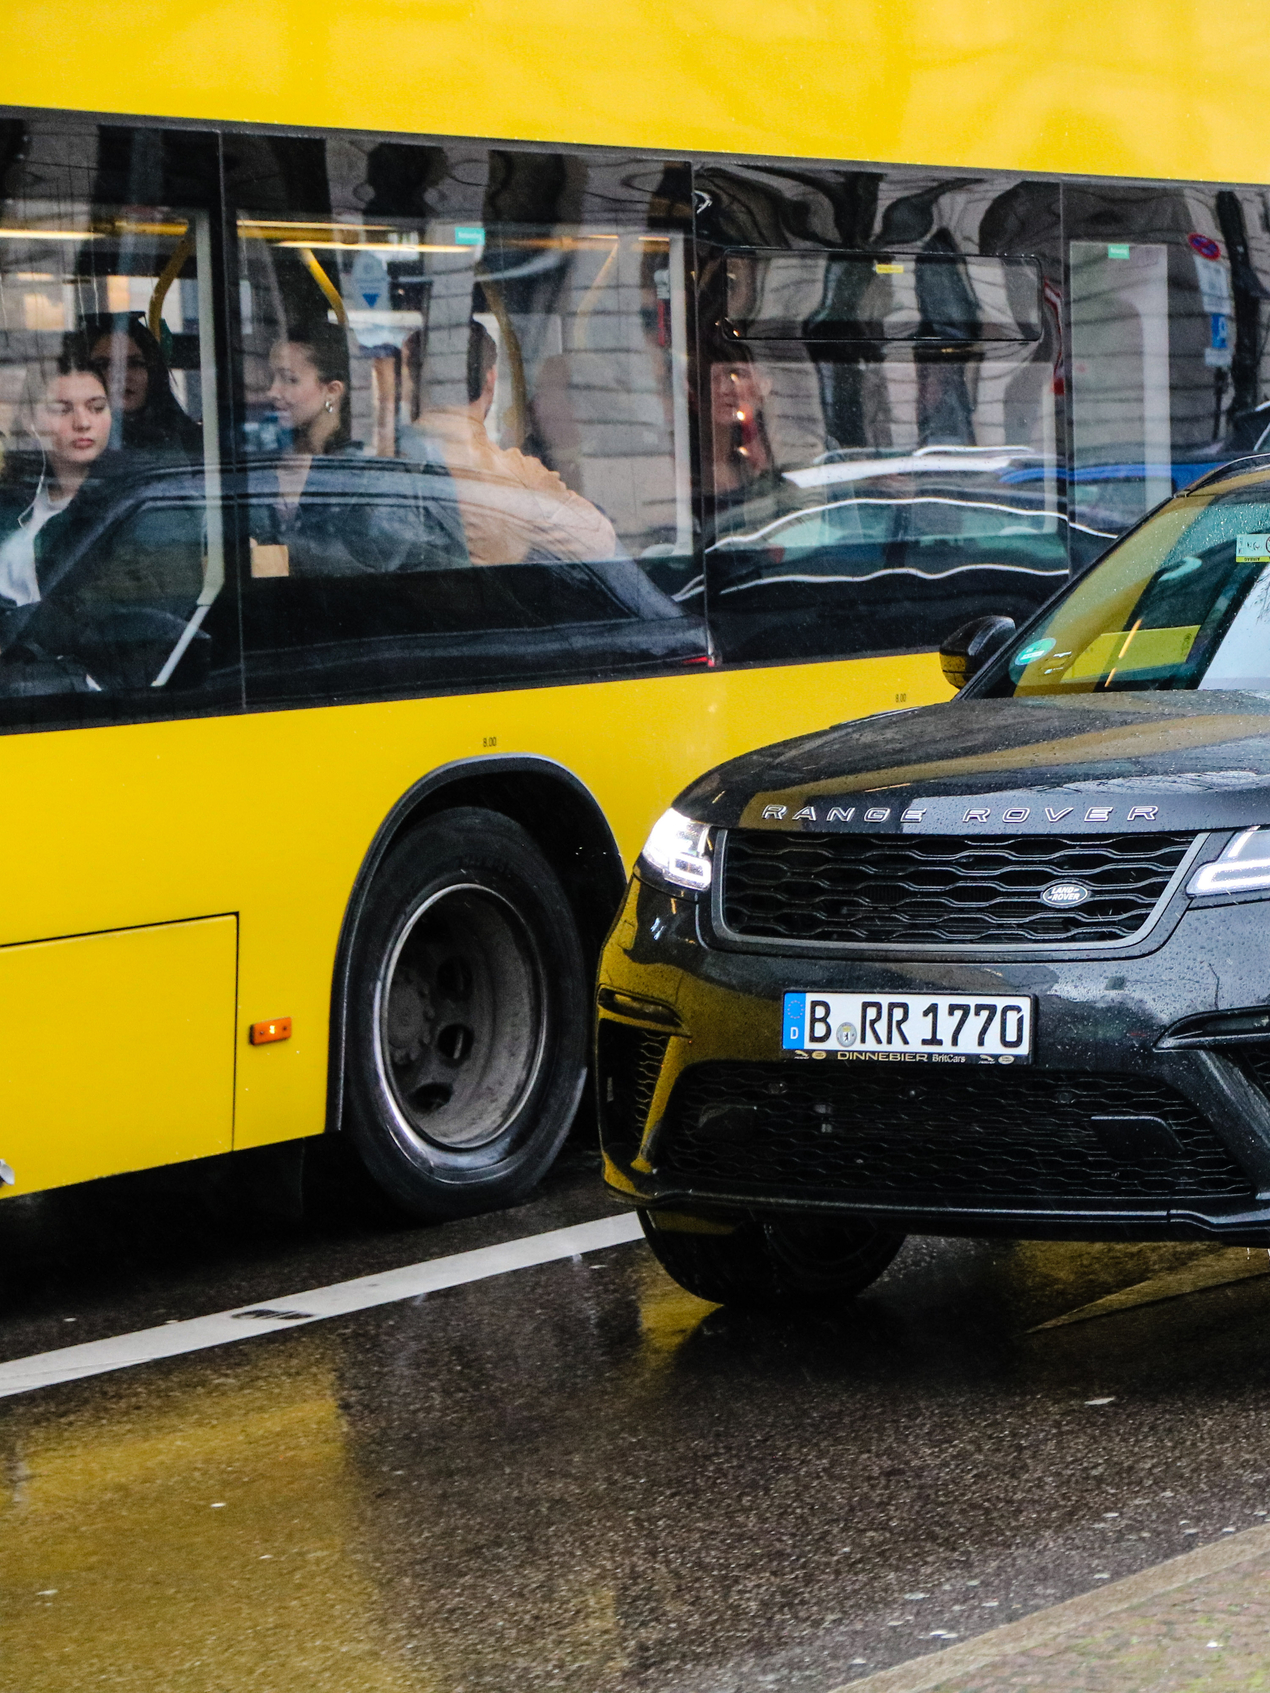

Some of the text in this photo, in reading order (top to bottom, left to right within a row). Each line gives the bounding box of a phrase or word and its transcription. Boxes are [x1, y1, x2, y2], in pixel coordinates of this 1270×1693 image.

[762, 804, 1159, 824] RANGE ROVER
[809, 1000, 1025, 1049] B RR 1770
[790, 1027, 799, 1039] D
[837, 1051, 929, 1062] DINNEBIER
[932, 1053, 966, 1064] BritCars
